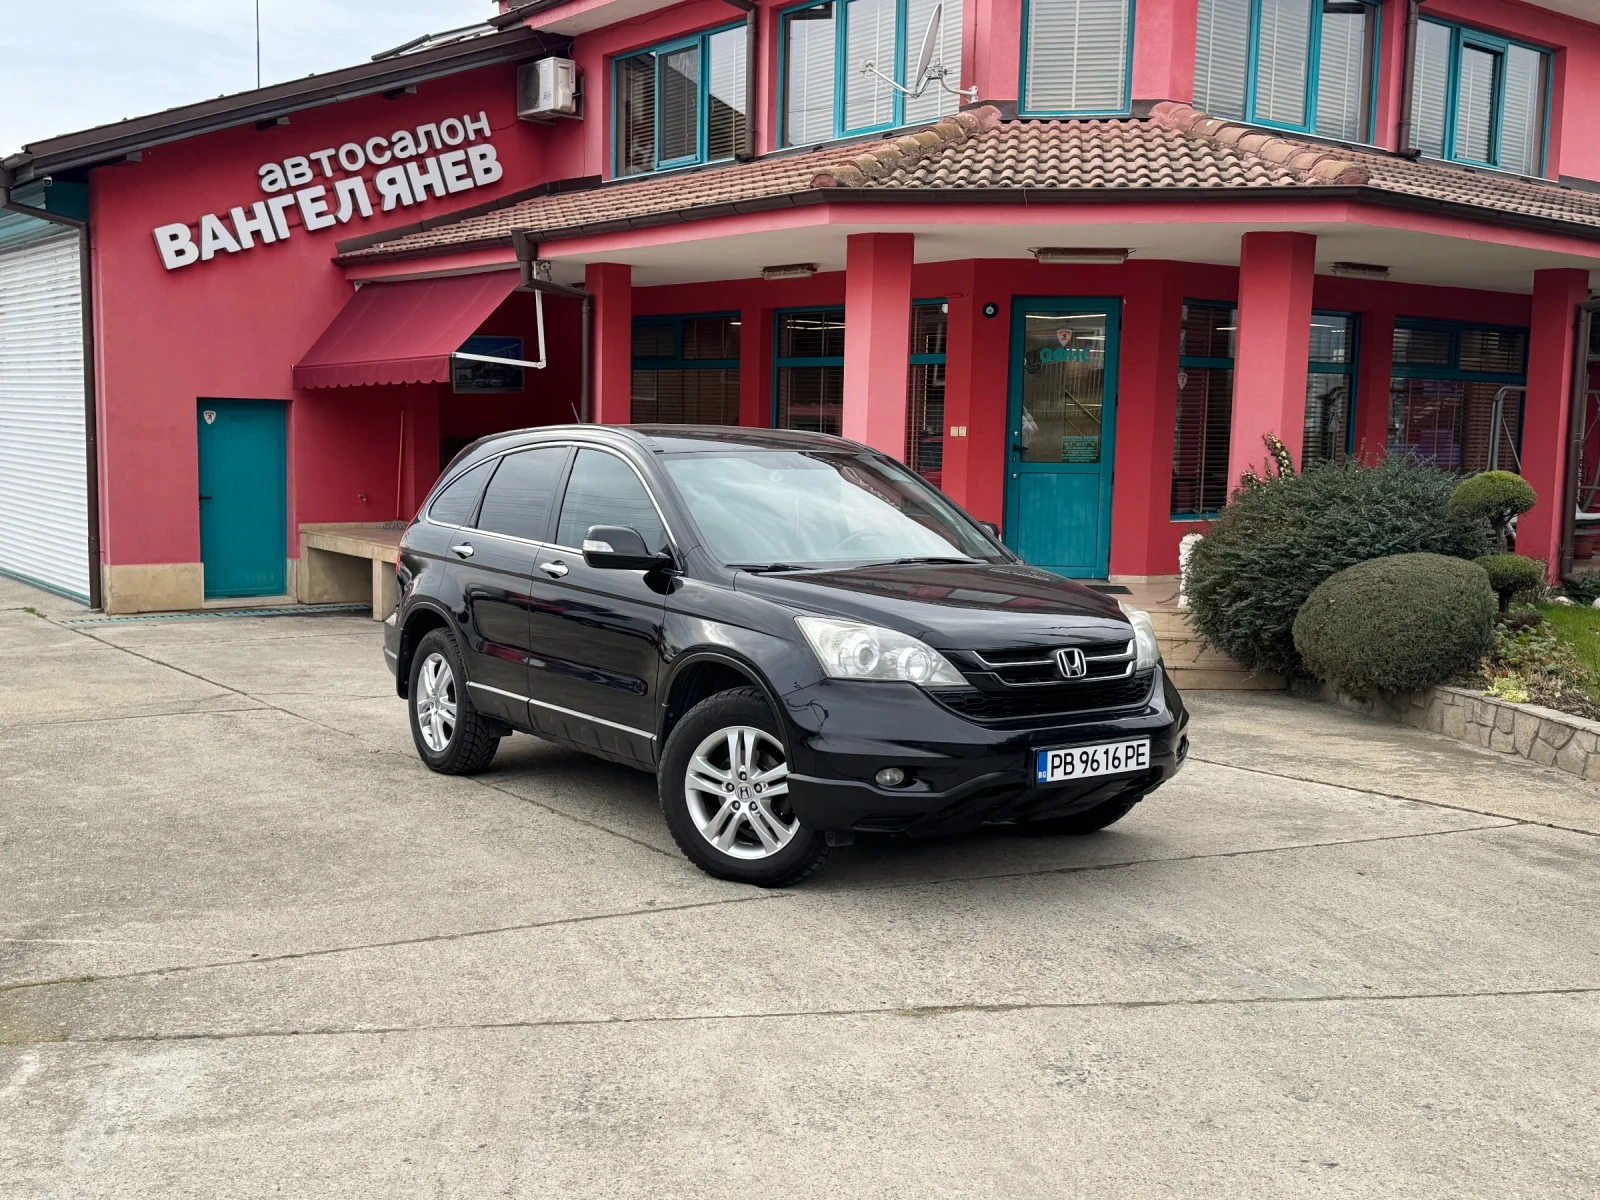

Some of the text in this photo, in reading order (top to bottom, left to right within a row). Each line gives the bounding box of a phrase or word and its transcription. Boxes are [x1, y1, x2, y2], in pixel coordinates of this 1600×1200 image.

[258, 111, 492, 193] автосалон
[152, 143, 504, 271] ВАНГЕЛ ЯНЕВ
[1040, 347, 1091, 364] ОФИС
[1038, 771, 1047, 779] BG
[1050, 742, 1147, 778] PB 9616 PE
